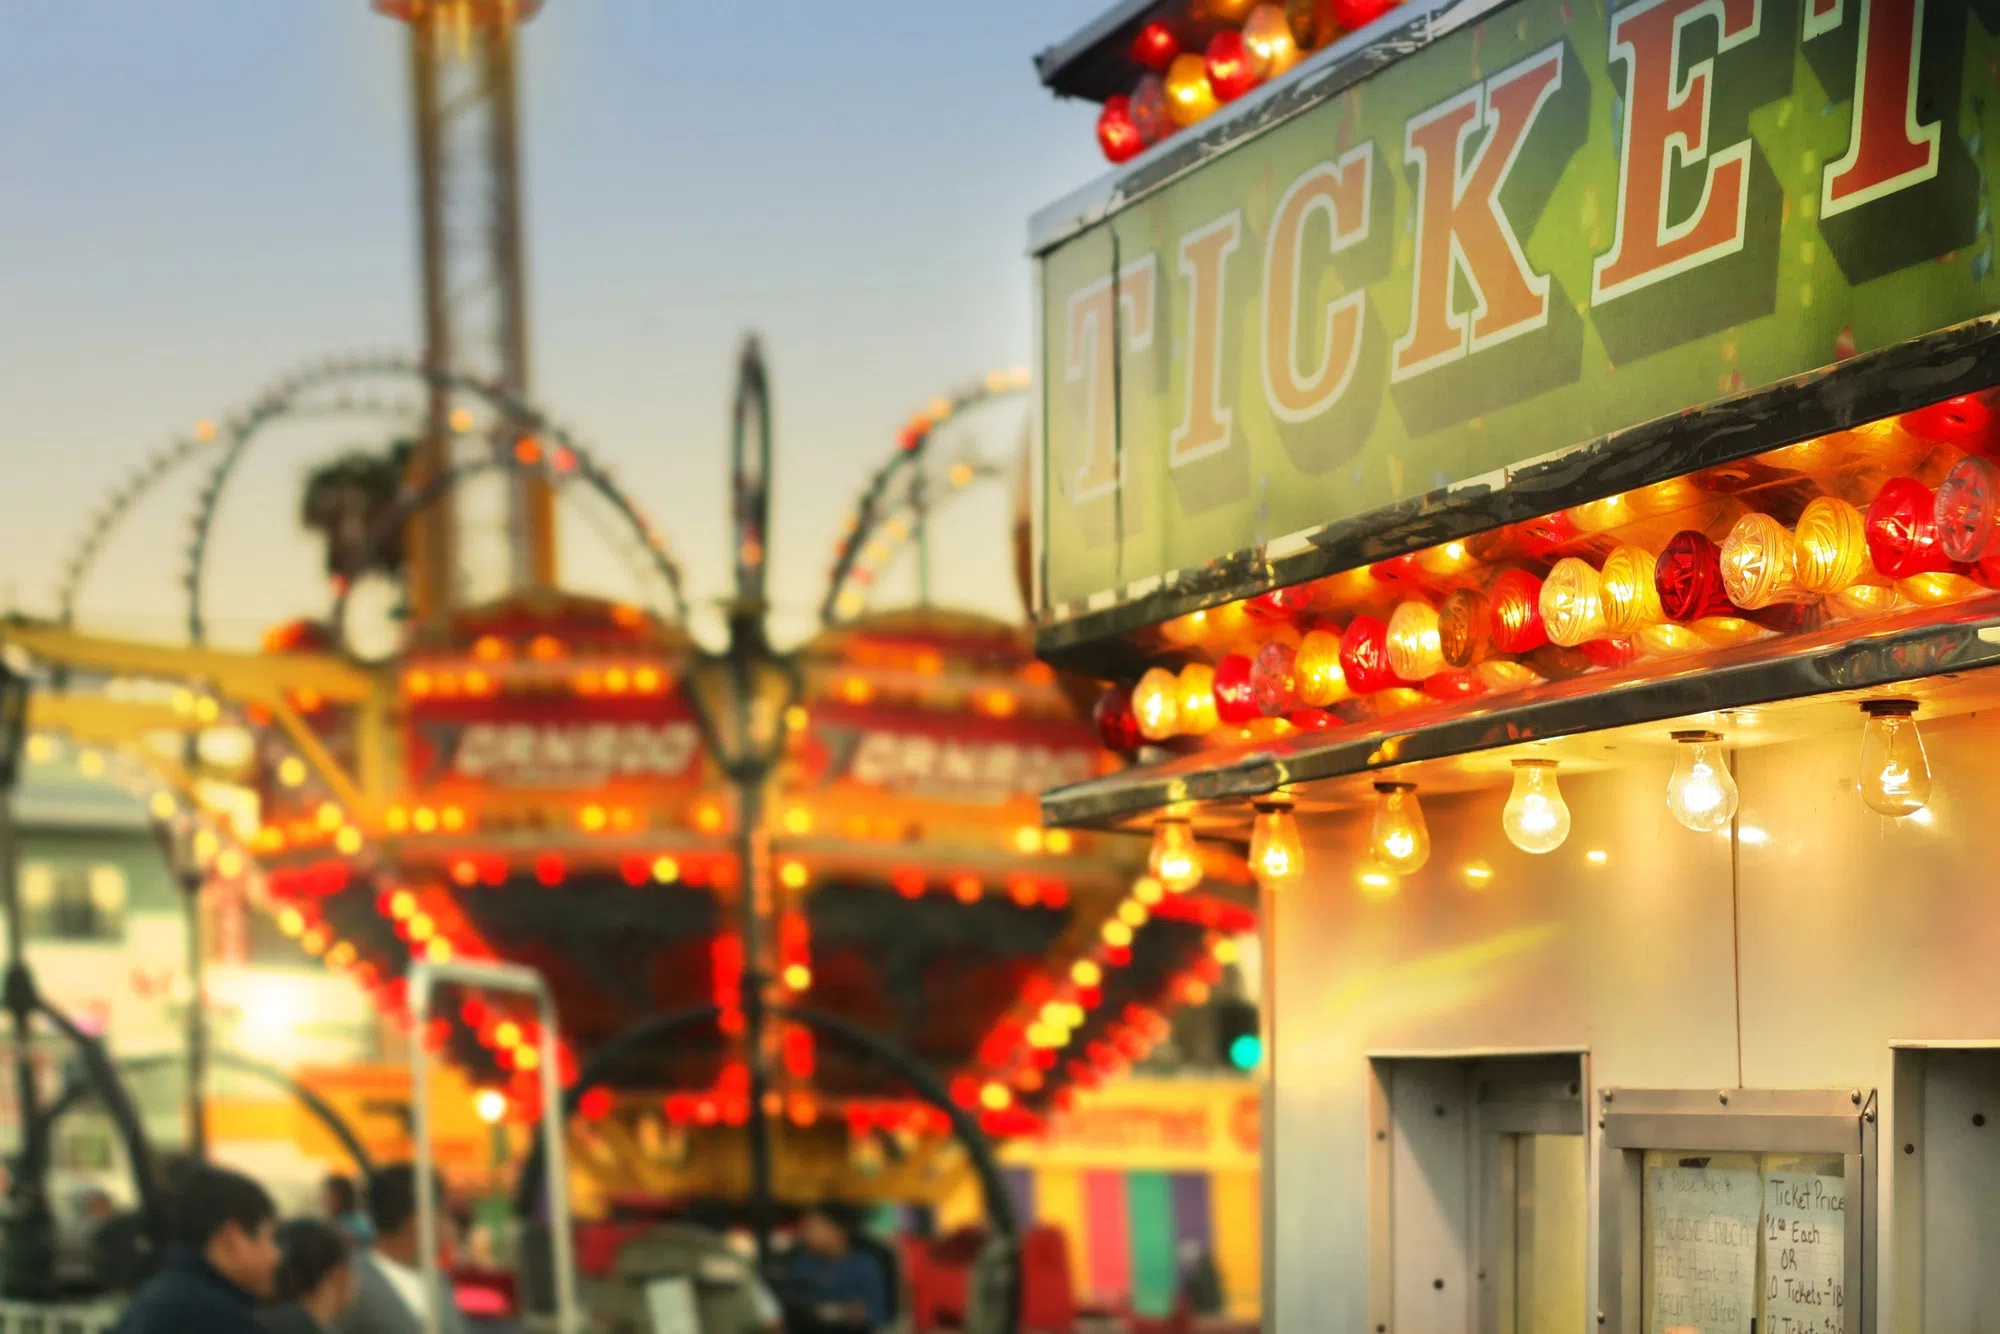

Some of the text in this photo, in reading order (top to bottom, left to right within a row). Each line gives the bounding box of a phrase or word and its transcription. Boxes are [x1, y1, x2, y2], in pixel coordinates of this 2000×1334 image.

[1065, 0, 1942, 503] TICKET
[1770, 1179, 1811, 1211] Ticket
[1791, 1220, 1821, 1244] Each
[1781, 1248, 1798, 1271] OR
[1784, 1278, 1822, 1306] Tickets
